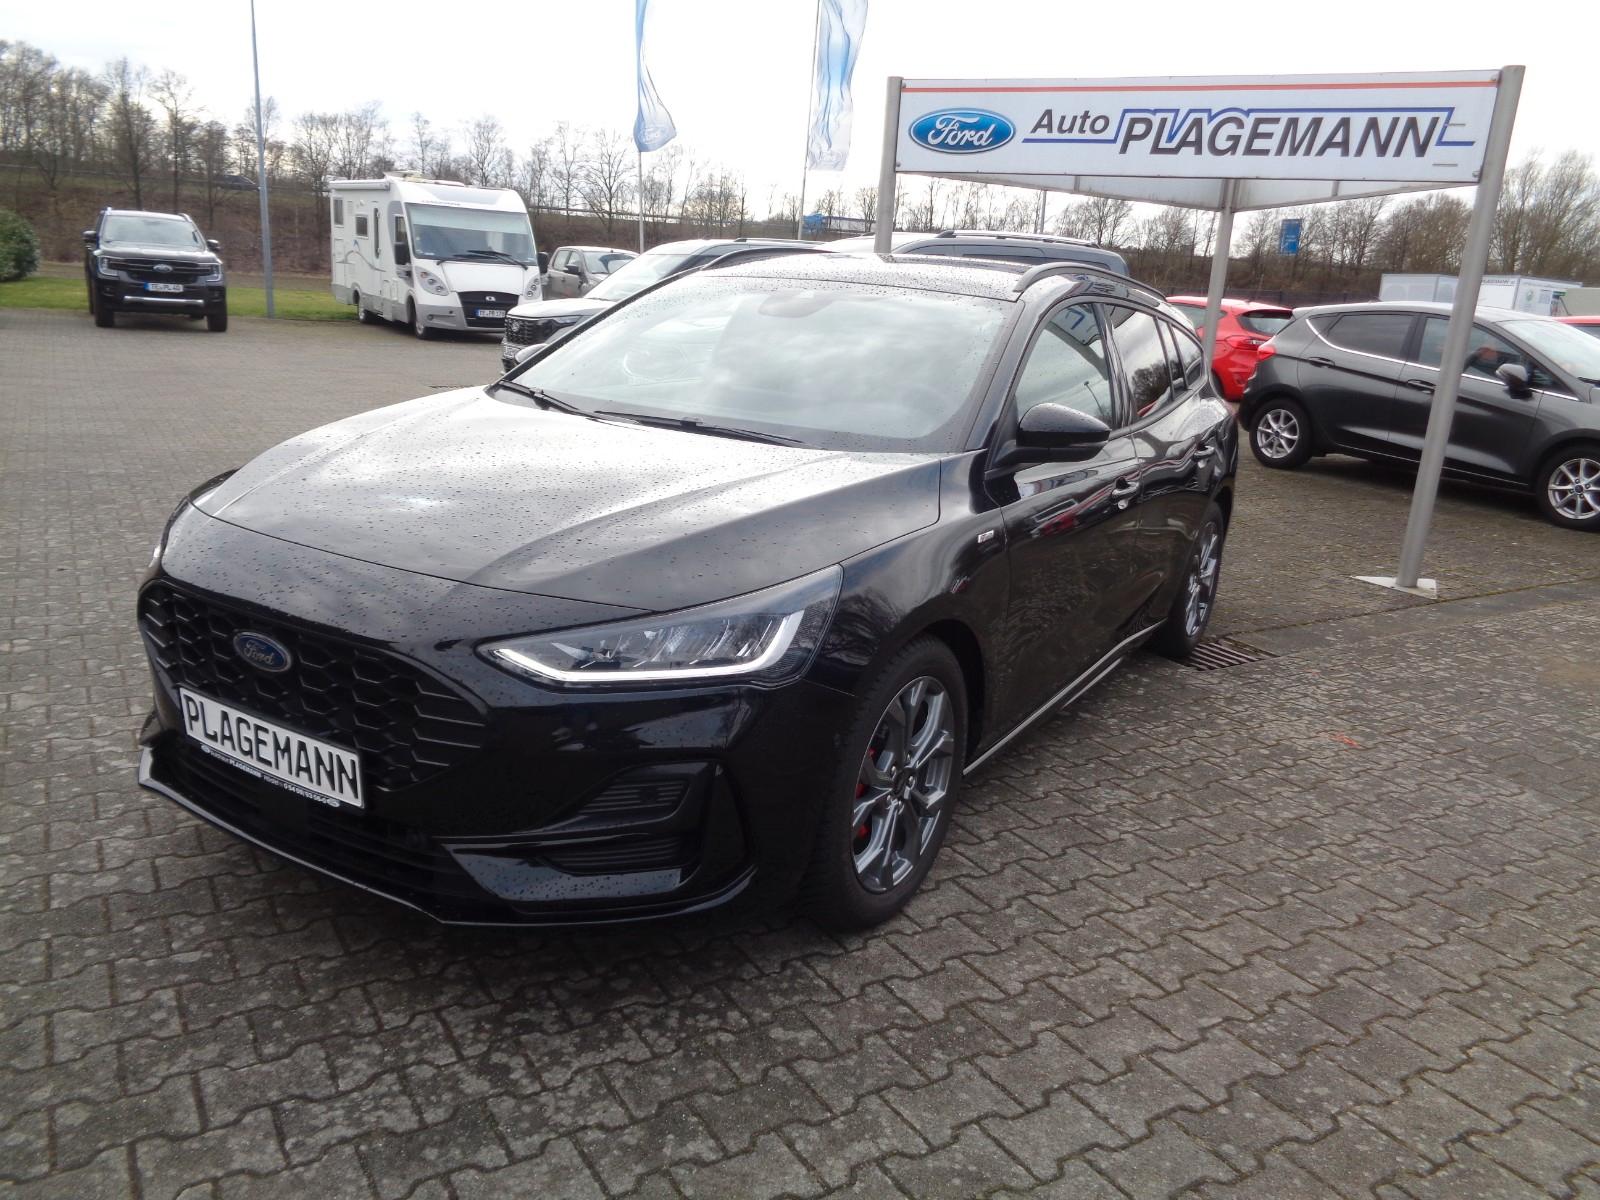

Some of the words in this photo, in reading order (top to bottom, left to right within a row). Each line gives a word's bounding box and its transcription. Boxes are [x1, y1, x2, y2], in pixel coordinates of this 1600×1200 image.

[927, 114, 993, 146] Ford
[1030, 108, 1110, 135] Auto
[1119, 116, 1440, 158] PLAGEMANN
[243, 639, 275, 665] Ford
[183, 694, 359, 800] PLAGEMANN
